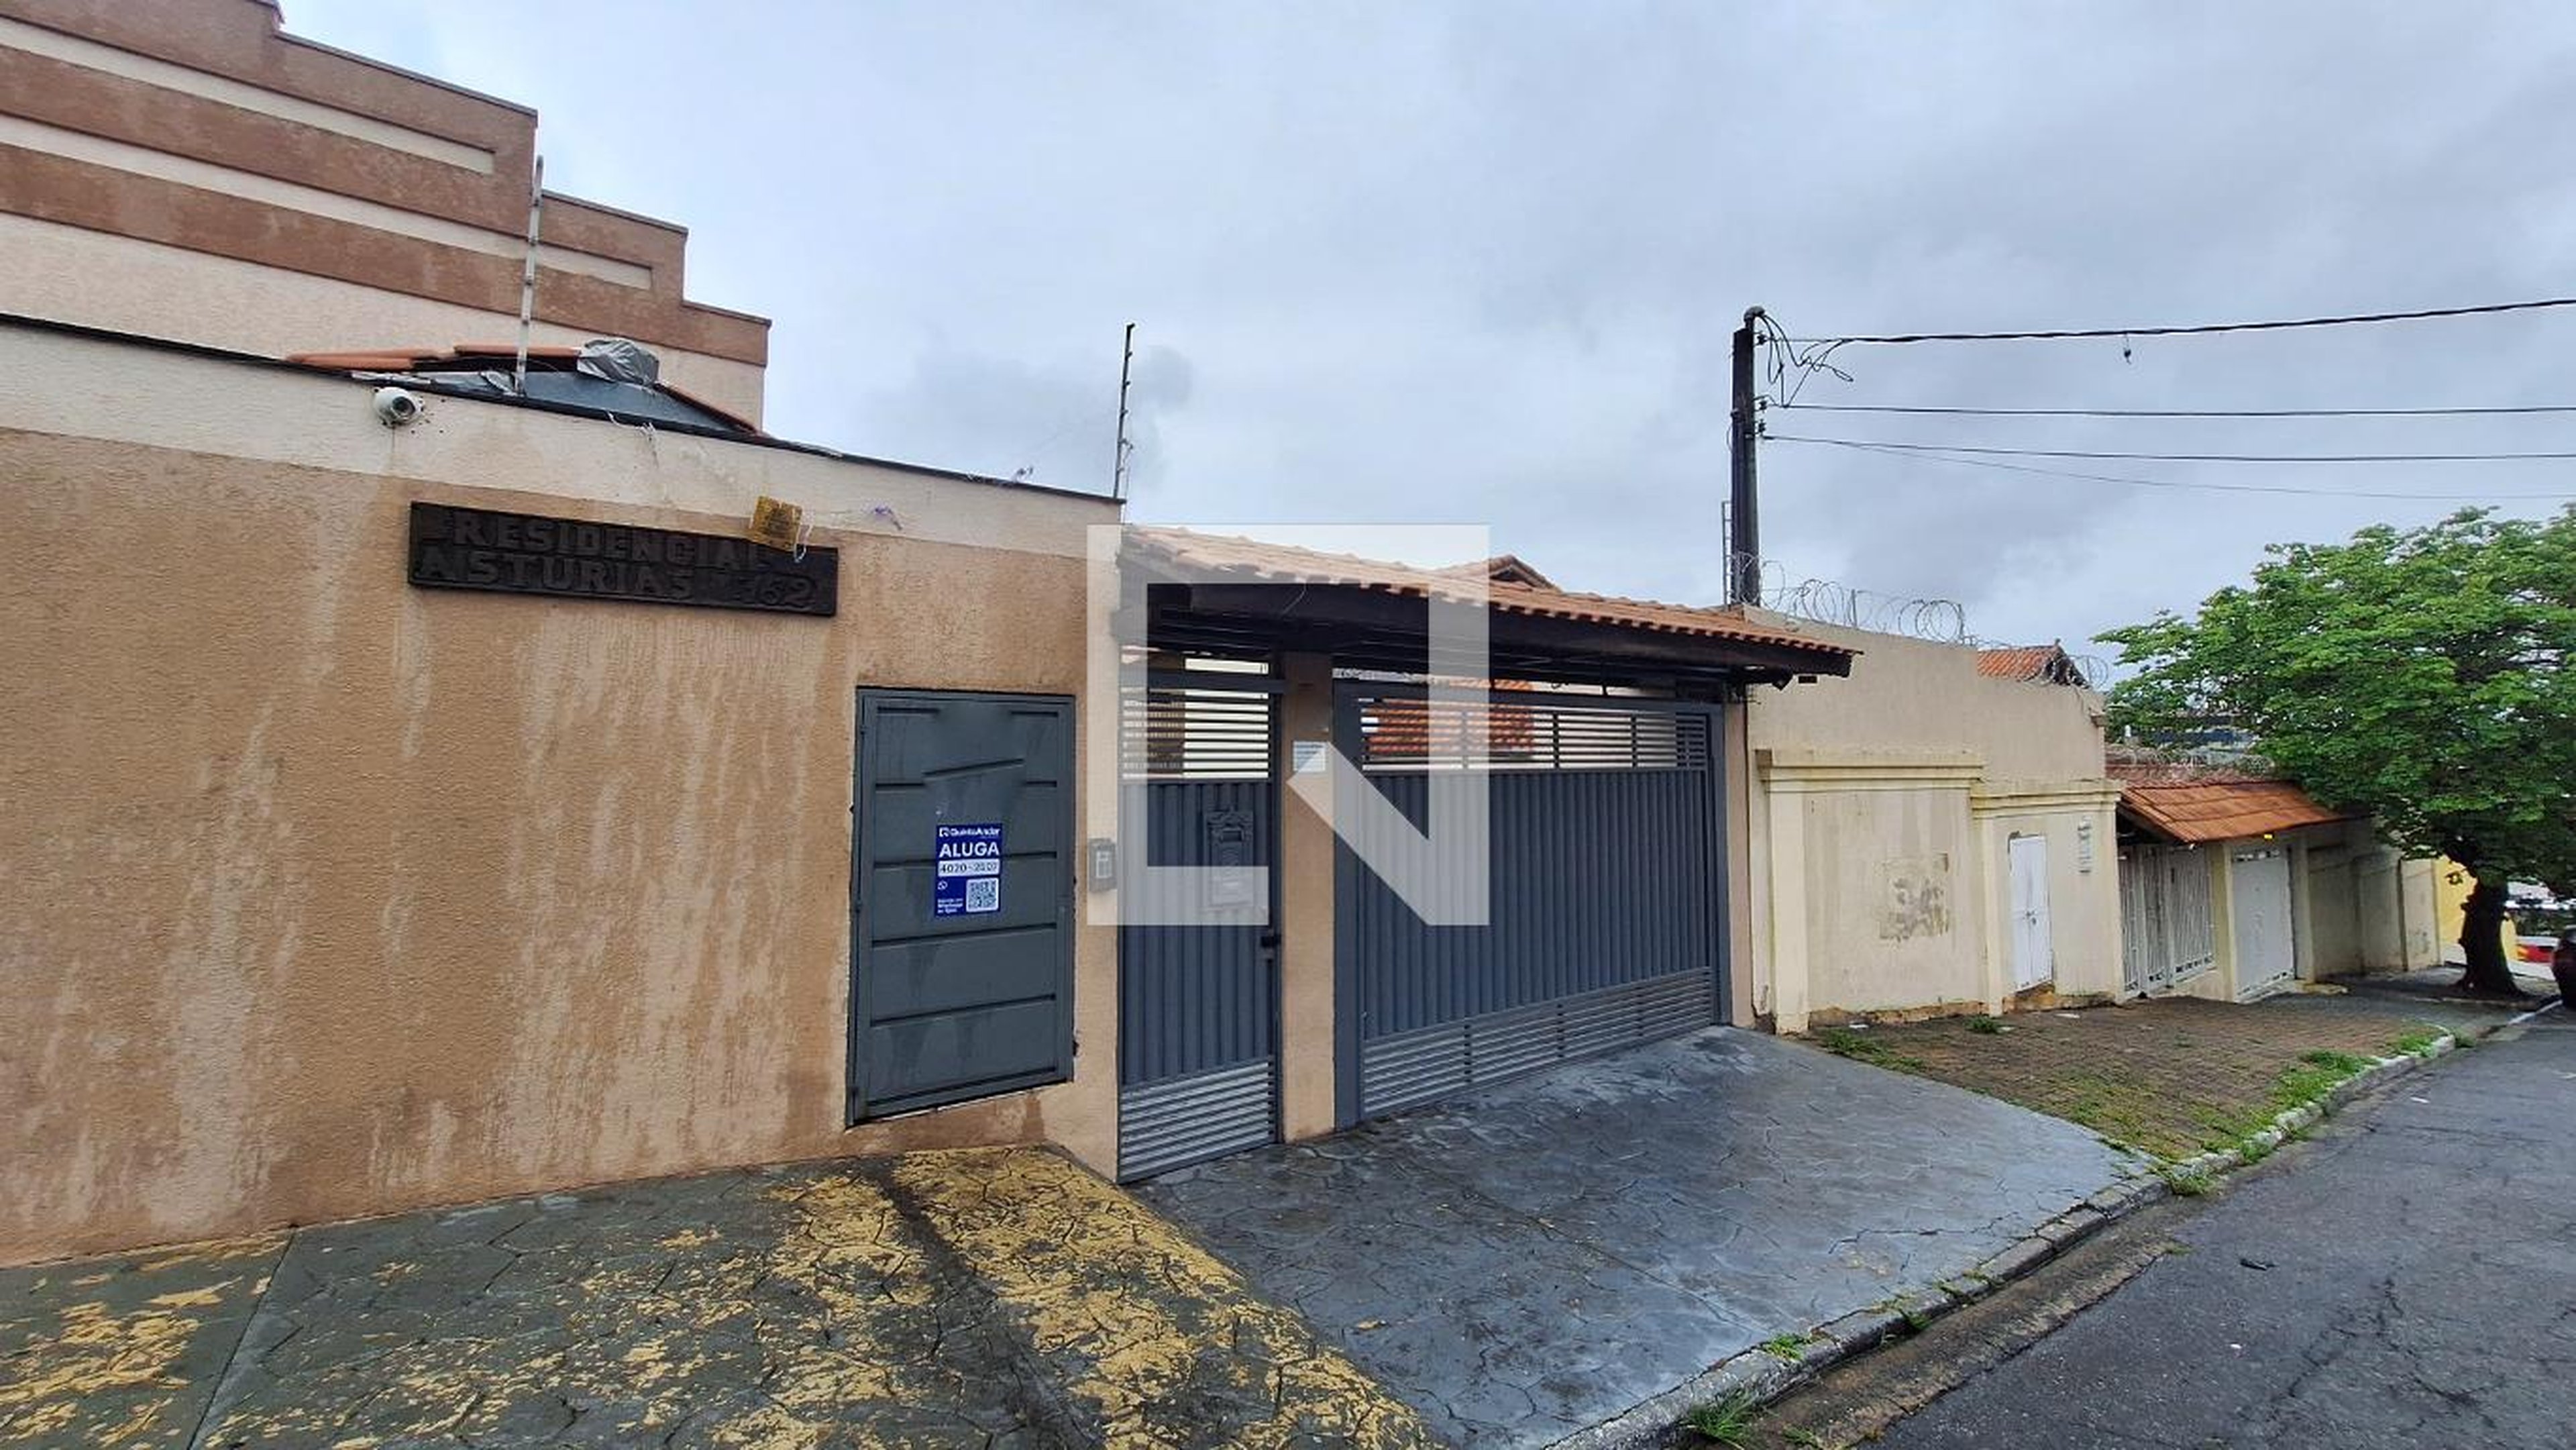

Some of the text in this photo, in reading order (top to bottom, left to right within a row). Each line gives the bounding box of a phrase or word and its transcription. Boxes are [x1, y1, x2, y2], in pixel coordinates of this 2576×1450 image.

[452, 510, 771, 570] RESIDENCIAL
[417, 545, 695, 598] ASTURIAS
[939, 841, 1000, 858] ALUGA
